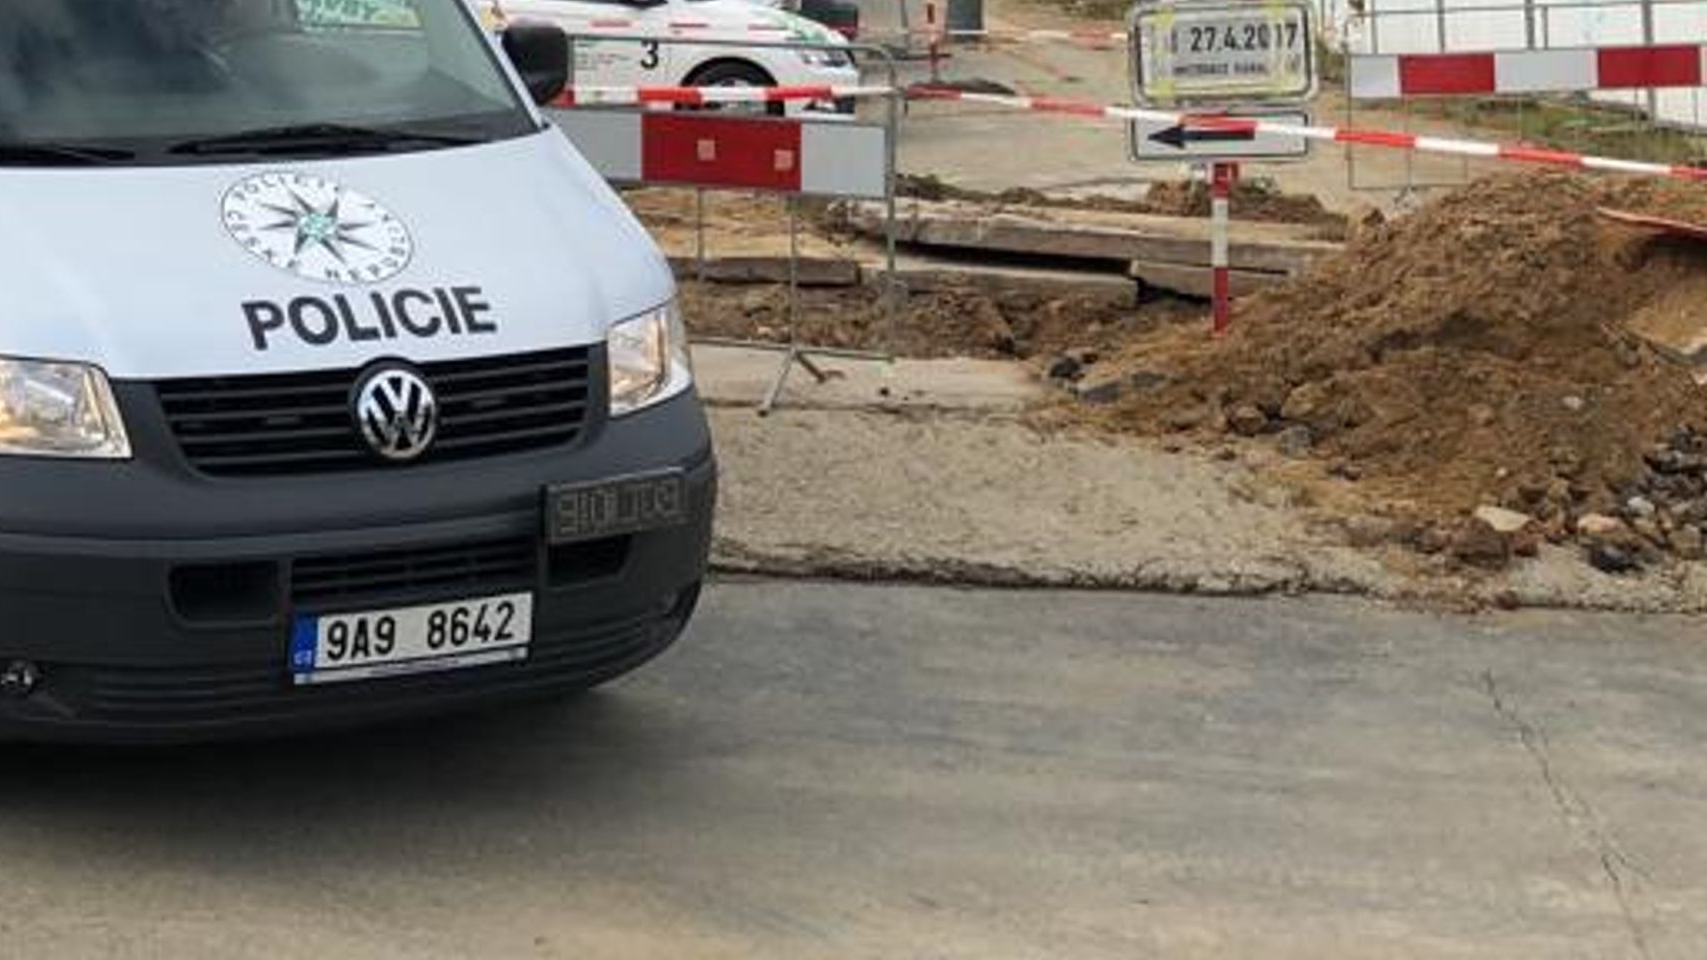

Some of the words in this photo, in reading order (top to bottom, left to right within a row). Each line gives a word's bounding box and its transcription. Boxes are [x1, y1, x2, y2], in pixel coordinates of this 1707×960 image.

[640, 40, 659, 70] 3
[241, 286, 499, 351] POLICIE
[327, 616, 396, 661] 9A9
[427, 600, 515, 649] 8642
